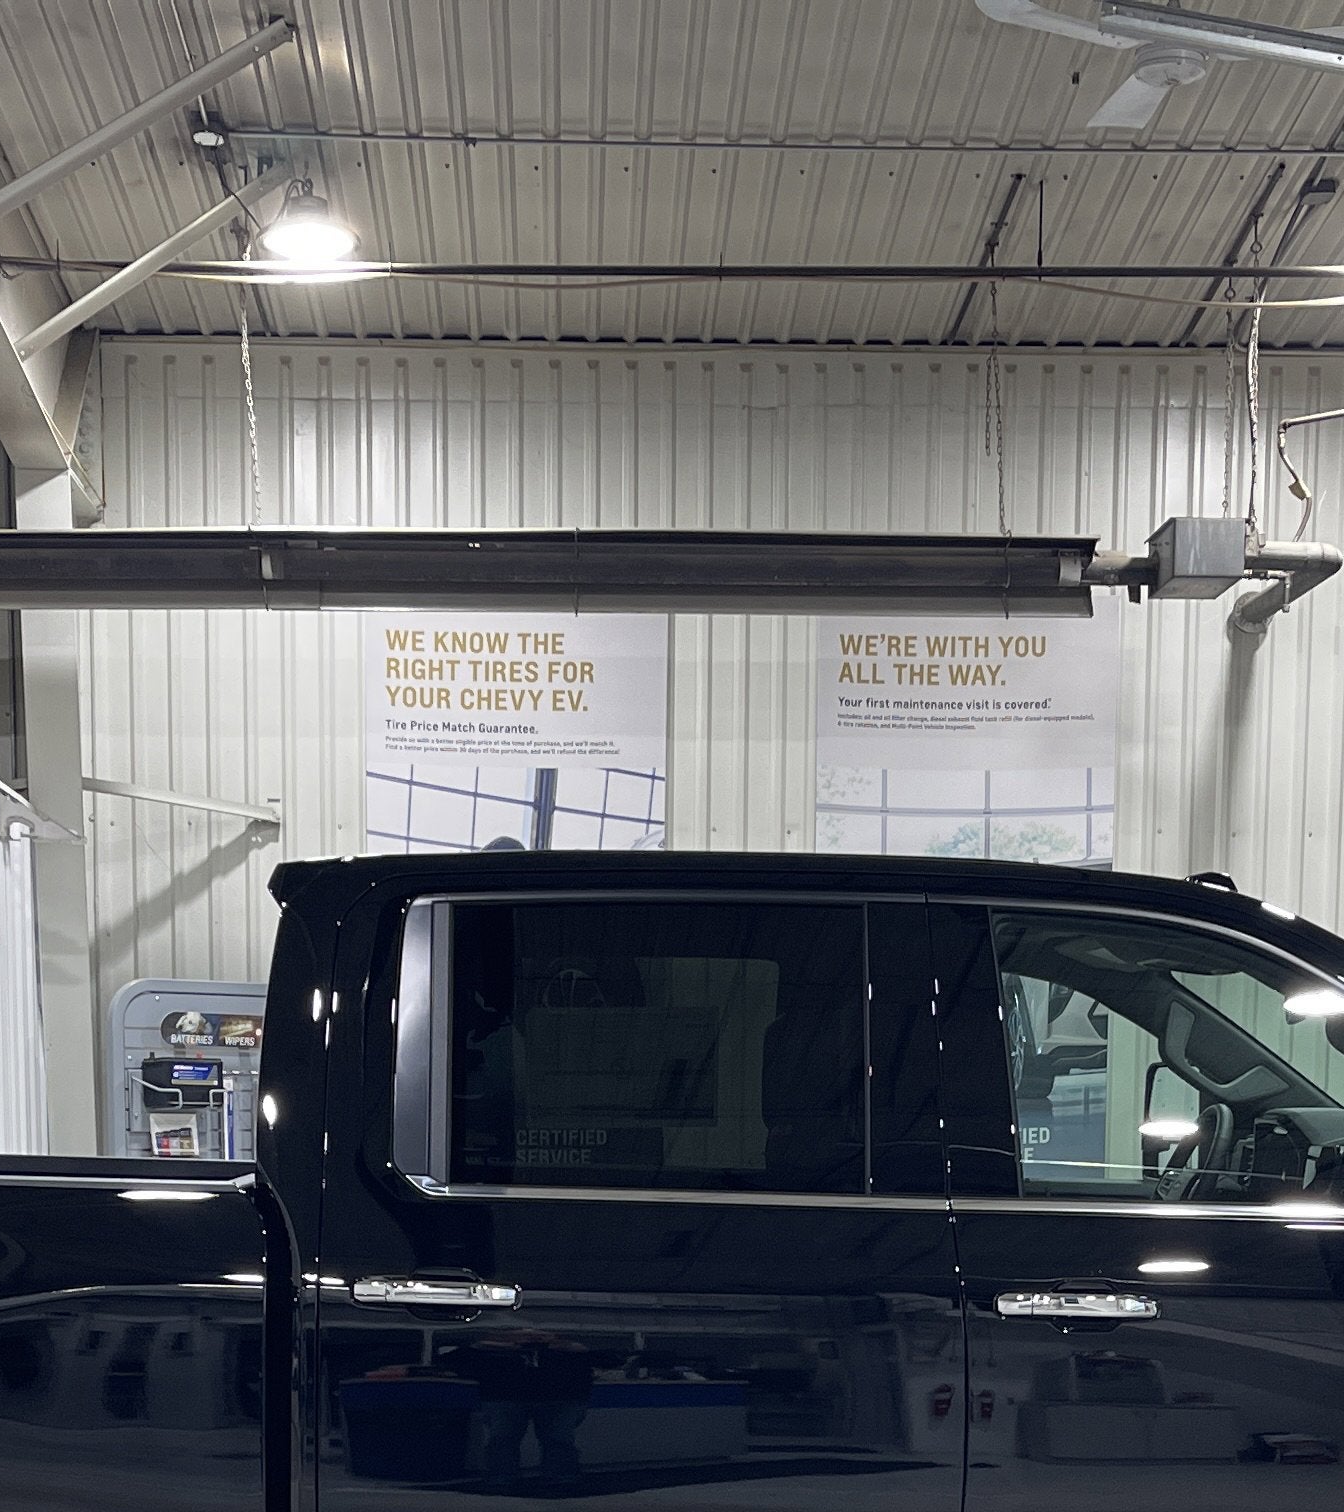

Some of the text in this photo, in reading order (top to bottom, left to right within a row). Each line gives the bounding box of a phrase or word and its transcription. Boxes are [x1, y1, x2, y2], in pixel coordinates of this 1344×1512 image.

[385, 629, 565, 655] WE KNOW THE
[839, 633, 1046, 658] WE'RE WITH YOU
[385, 657, 595, 683] RIGHT TIRES FOR
[838, 661, 1007, 686] ALL THE WAY.
[385, 685, 589, 712] YOUR CHEVY EV.
[838, 696, 862, 708] Your
[865, 697, 890, 709] first
[892, 698, 963, 710] maintenance
[965, 698, 990, 711] visit
[992, 698, 1002, 710] is
[385, 719, 539, 735] Tire Price Match Guarantee.
[170, 1033, 255, 1046] BATTERIES WIPERS
[516, 1128, 608, 1146] CERTIFIED
[515, 1148, 593, 1165] SERVICE
